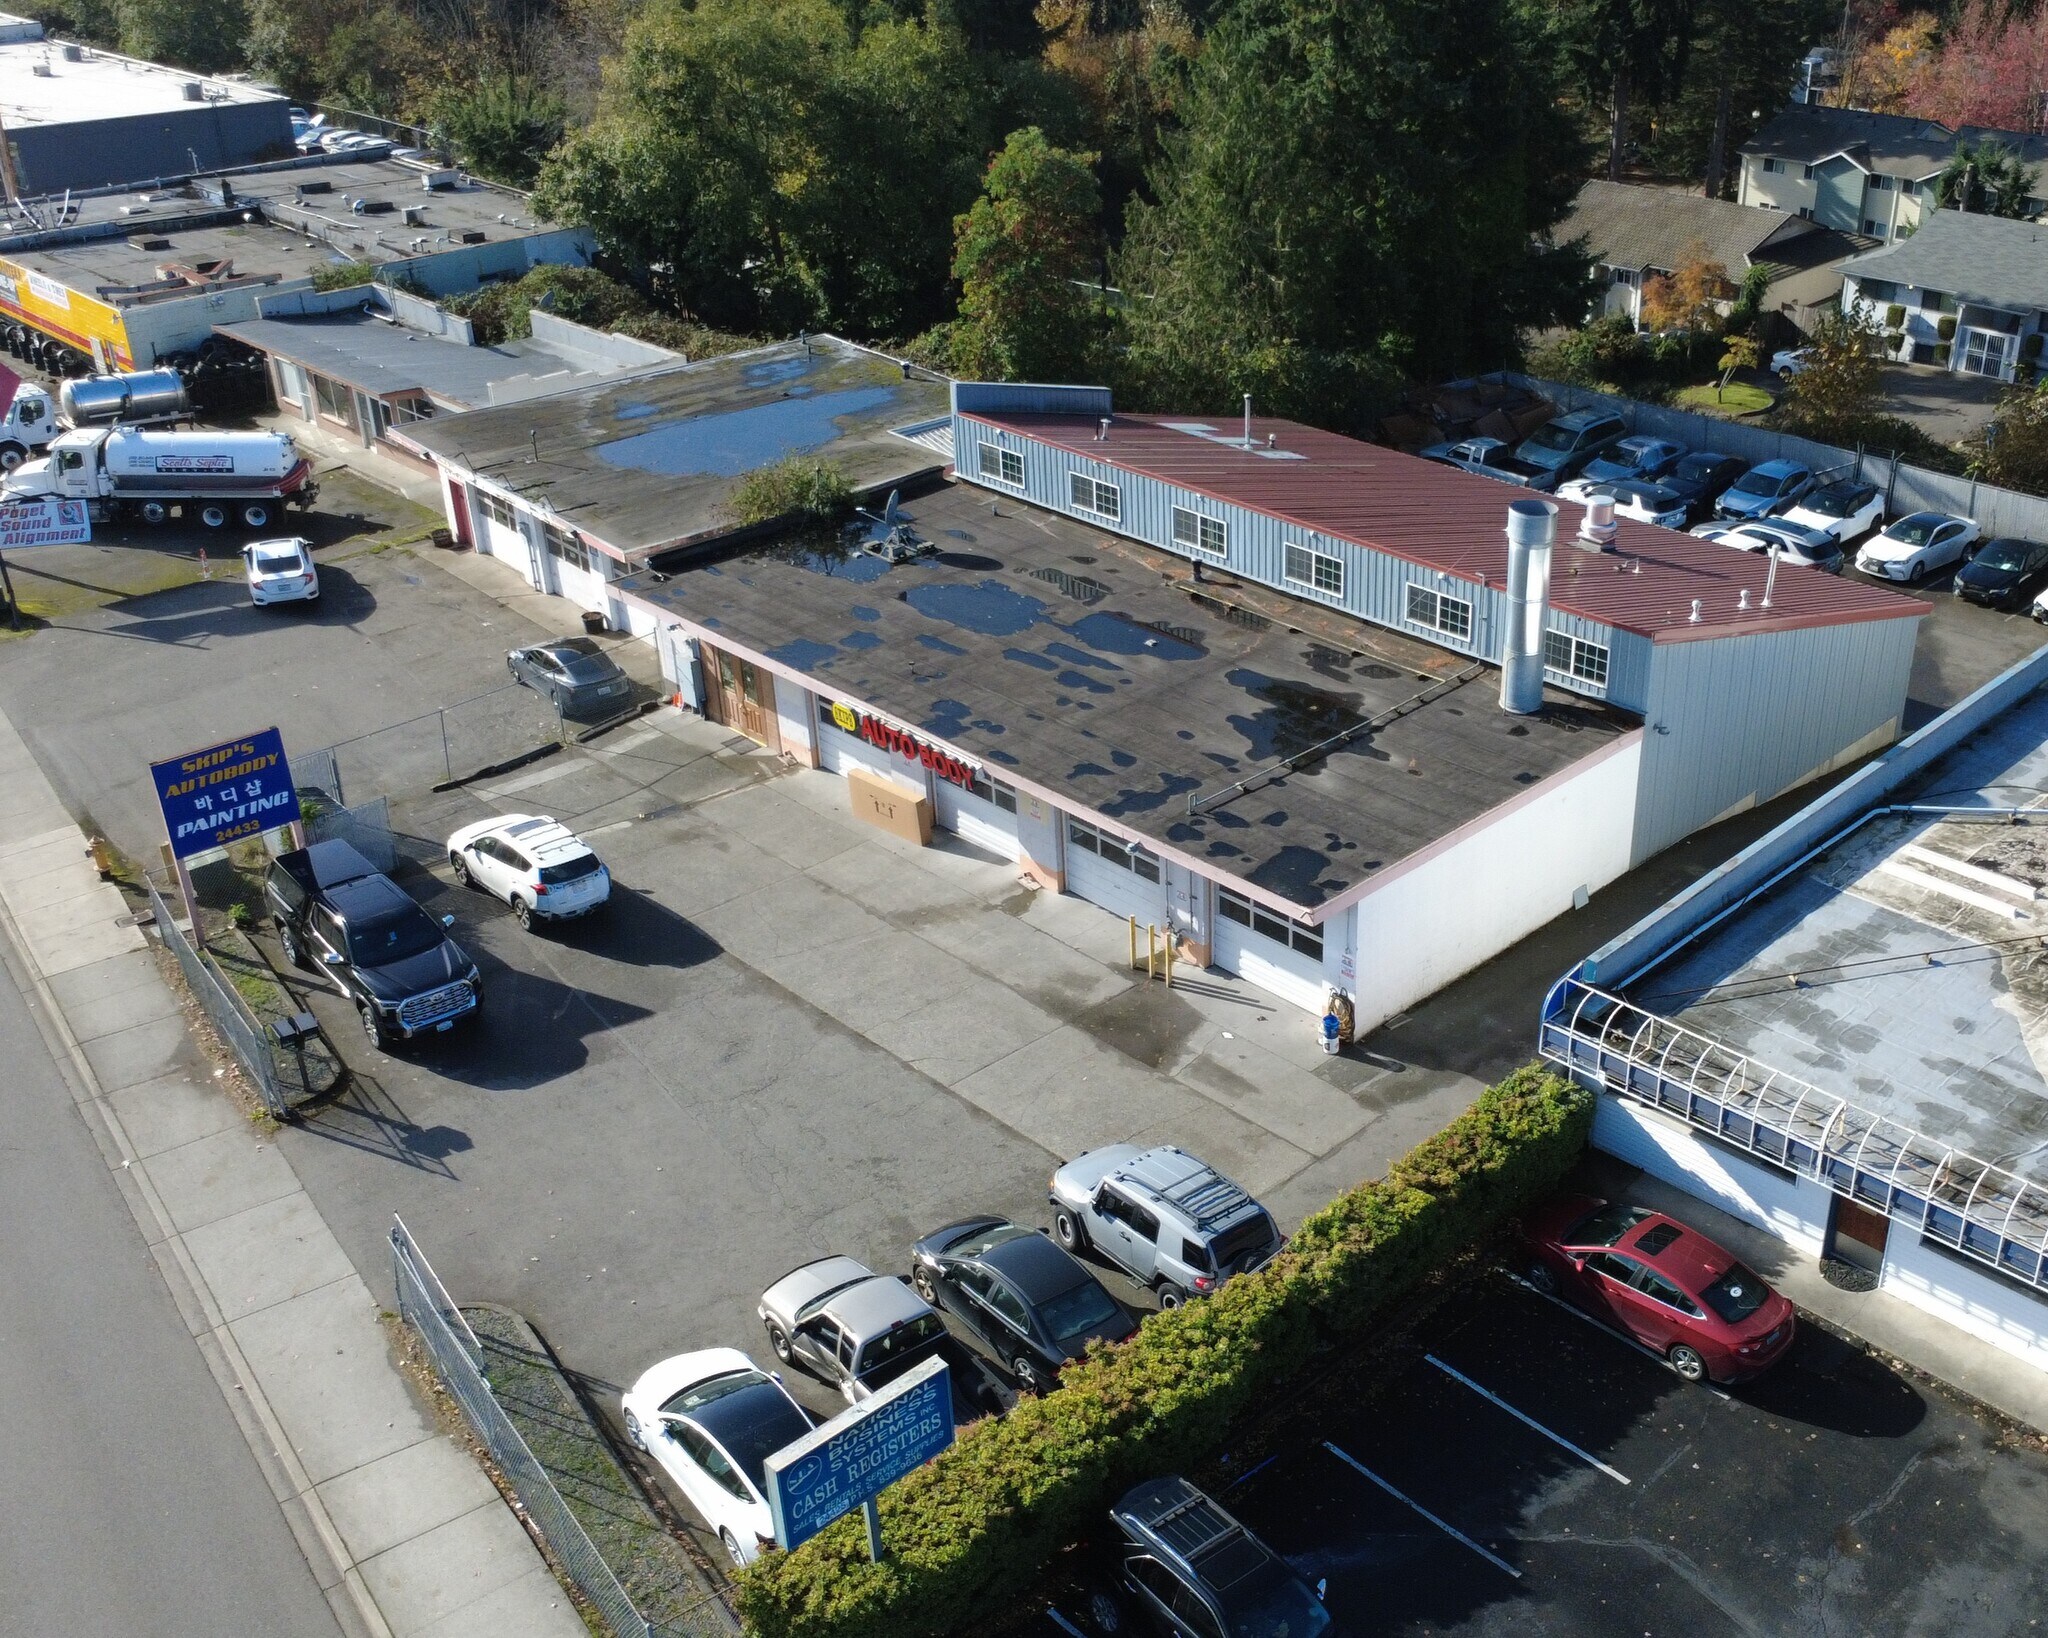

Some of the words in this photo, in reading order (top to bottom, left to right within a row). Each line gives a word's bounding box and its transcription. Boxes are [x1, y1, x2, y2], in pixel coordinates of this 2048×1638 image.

[195, 457, 229, 468] Septic
[0, 517, 52, 532] Sound
[3, 527, 86, 545] Alignment
[165, 752, 279, 799] AUTOBODY
[181, 741, 255, 775] SKIP'S
[862, 714, 915, 760] AUTO
[918, 743, 974, 791] BODY
[177, 790, 289, 839] PAINTING
[215, 819, 261, 843] 24433
[828, 1381, 937, 1450] NATIONAL
[828, 1389, 937, 1462] BUSINESS
[792, 1476, 839, 1520] CASH
[847, 1411, 942, 1483] REGISTERS
[830, 1412, 917, 1473] SYSTEMS
[793, 1510, 821, 1535] SALES
[823, 1481, 862, 1512] RENTALS
[865, 1457, 901, 1484] SERVICE
[904, 1430, 945, 1459] SUPPLIES
